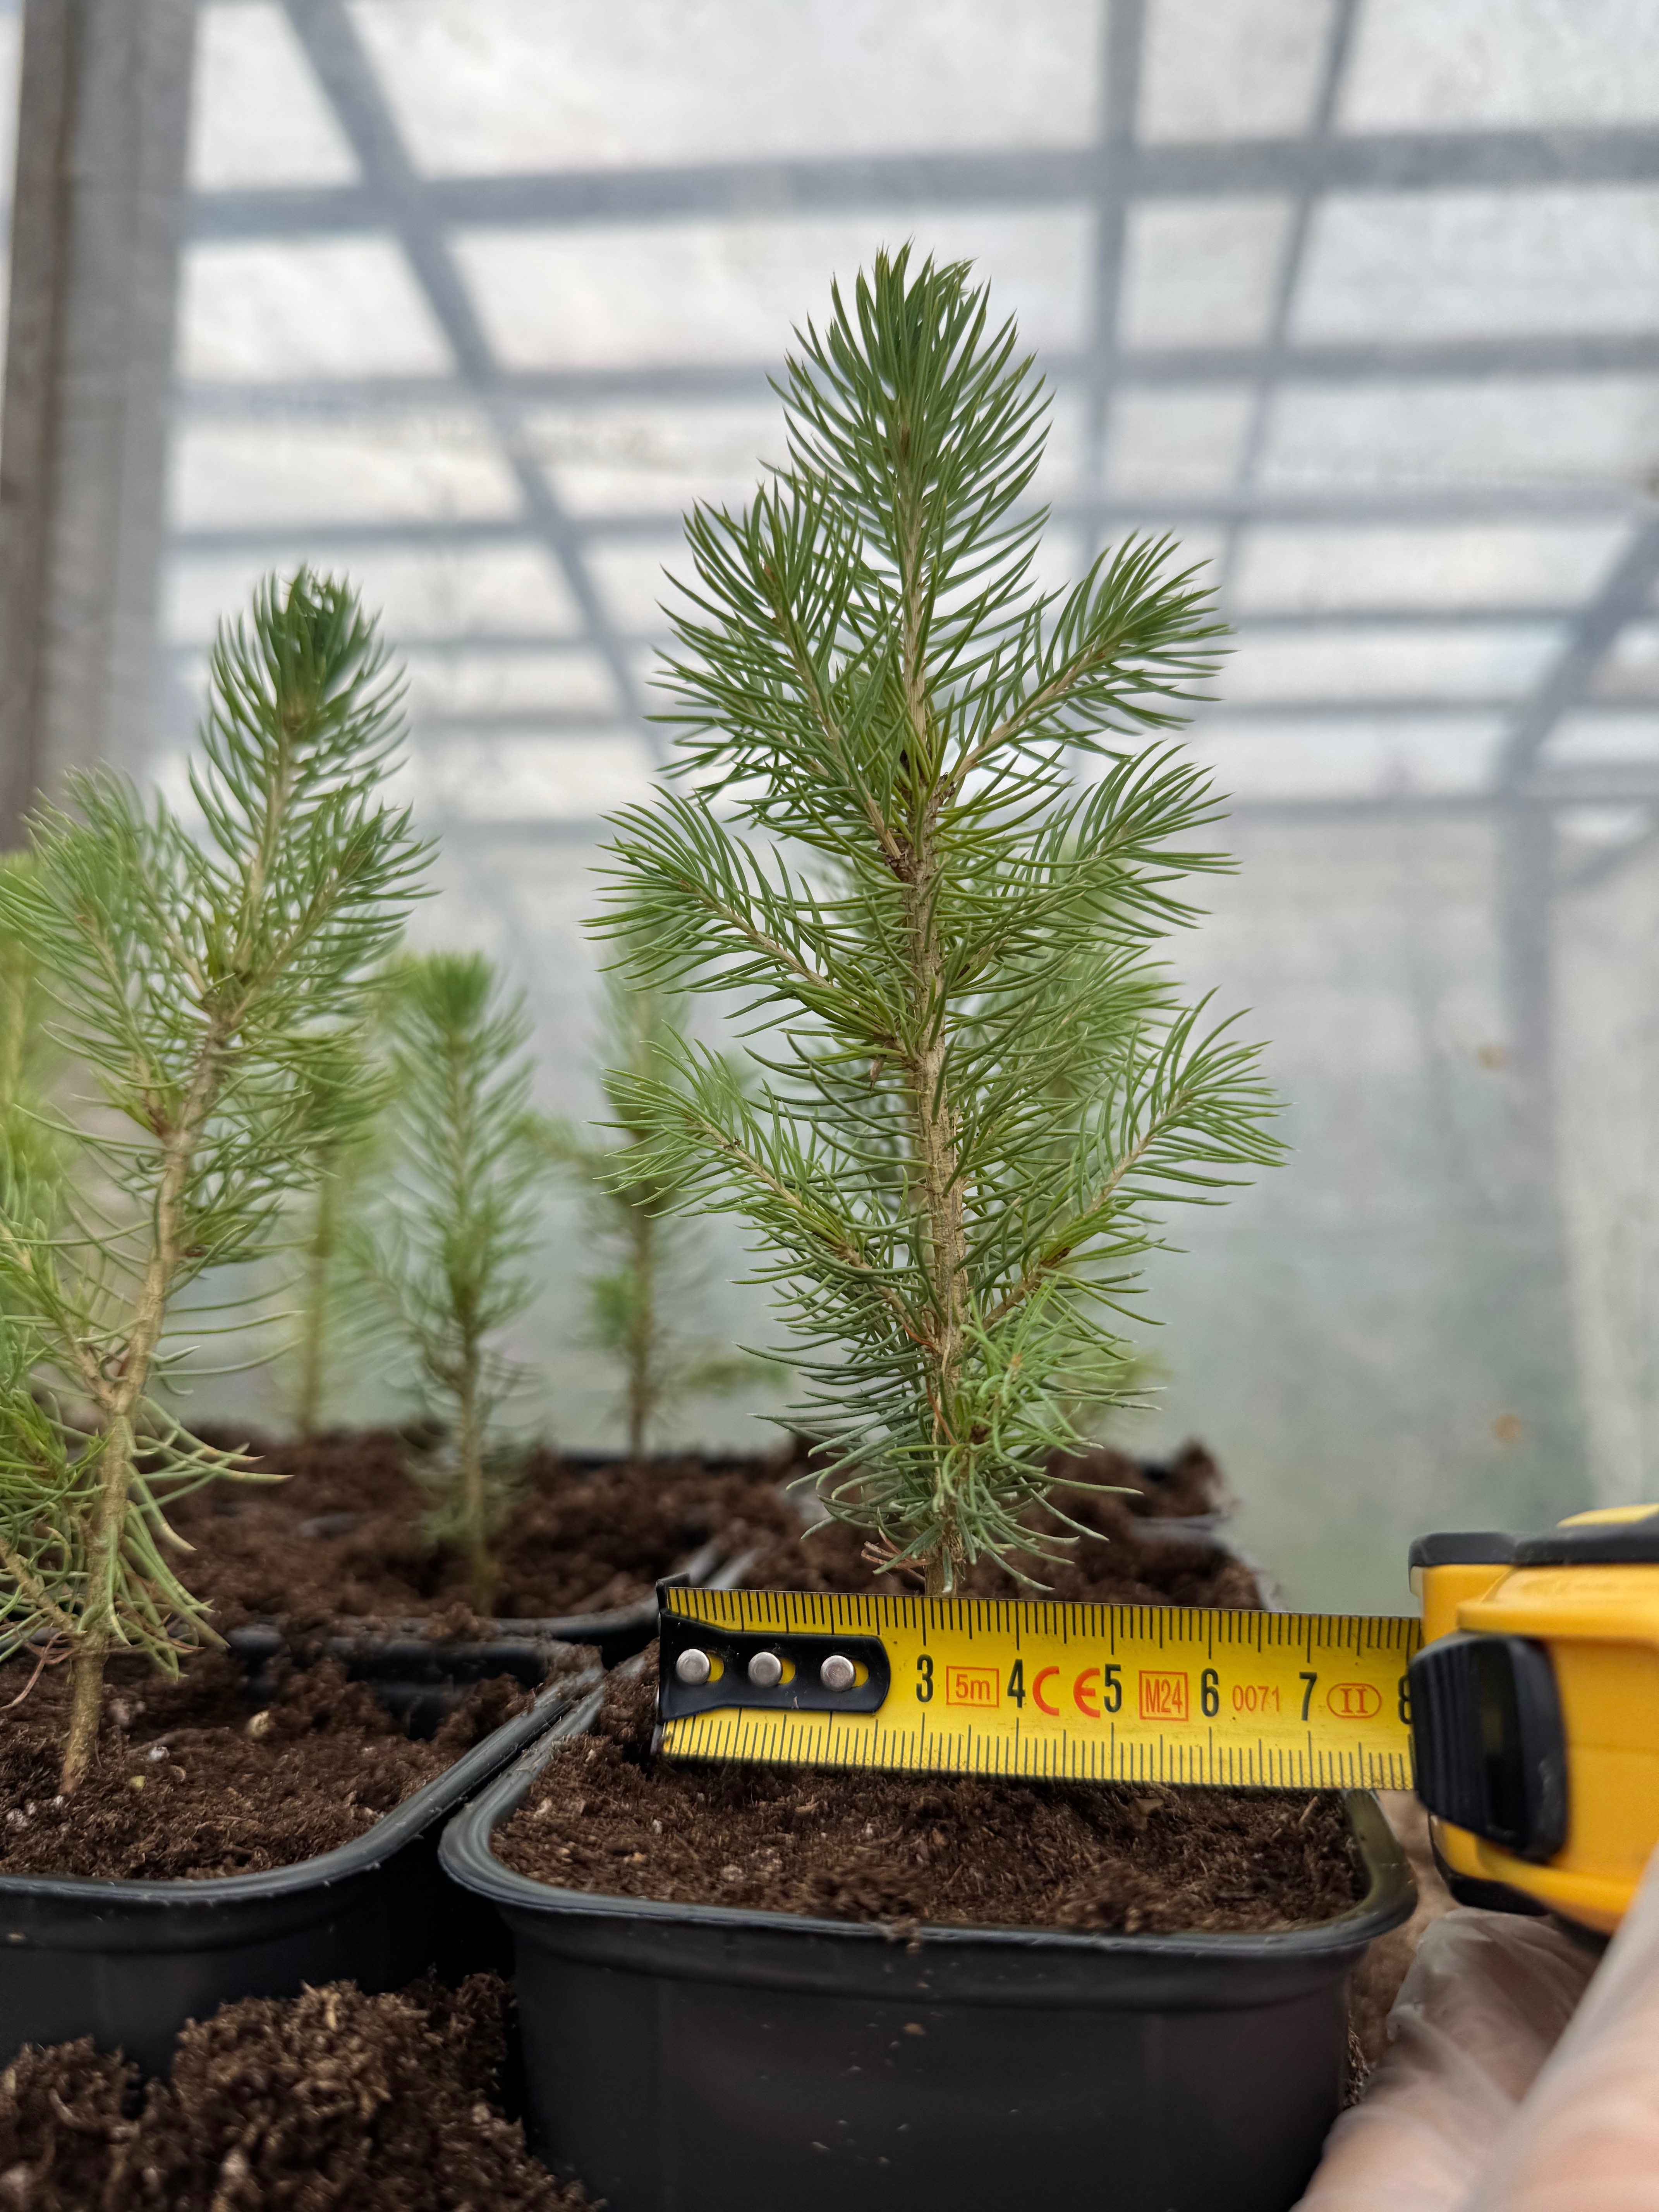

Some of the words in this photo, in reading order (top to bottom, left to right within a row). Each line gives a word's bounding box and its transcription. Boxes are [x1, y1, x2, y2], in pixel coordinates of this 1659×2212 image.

[916, 1654, 934, 1703] 3
[955, 1674, 990, 1701] 5m
[1007, 1659, 1025, 1708] 4
[1032, 1665, 1101, 1717] CE
[1103, 1663, 1121, 1713] 5
[1144, 1678, 1182, 1713] M24
[1200, 1668, 1219, 1717] 6
[1231, 1685, 1280, 1712] 0071
[1299, 1671, 1317, 1721] 7
[1341, 1688, 1367, 1714] II
[1398, 1675, 1412, 1724] 8
